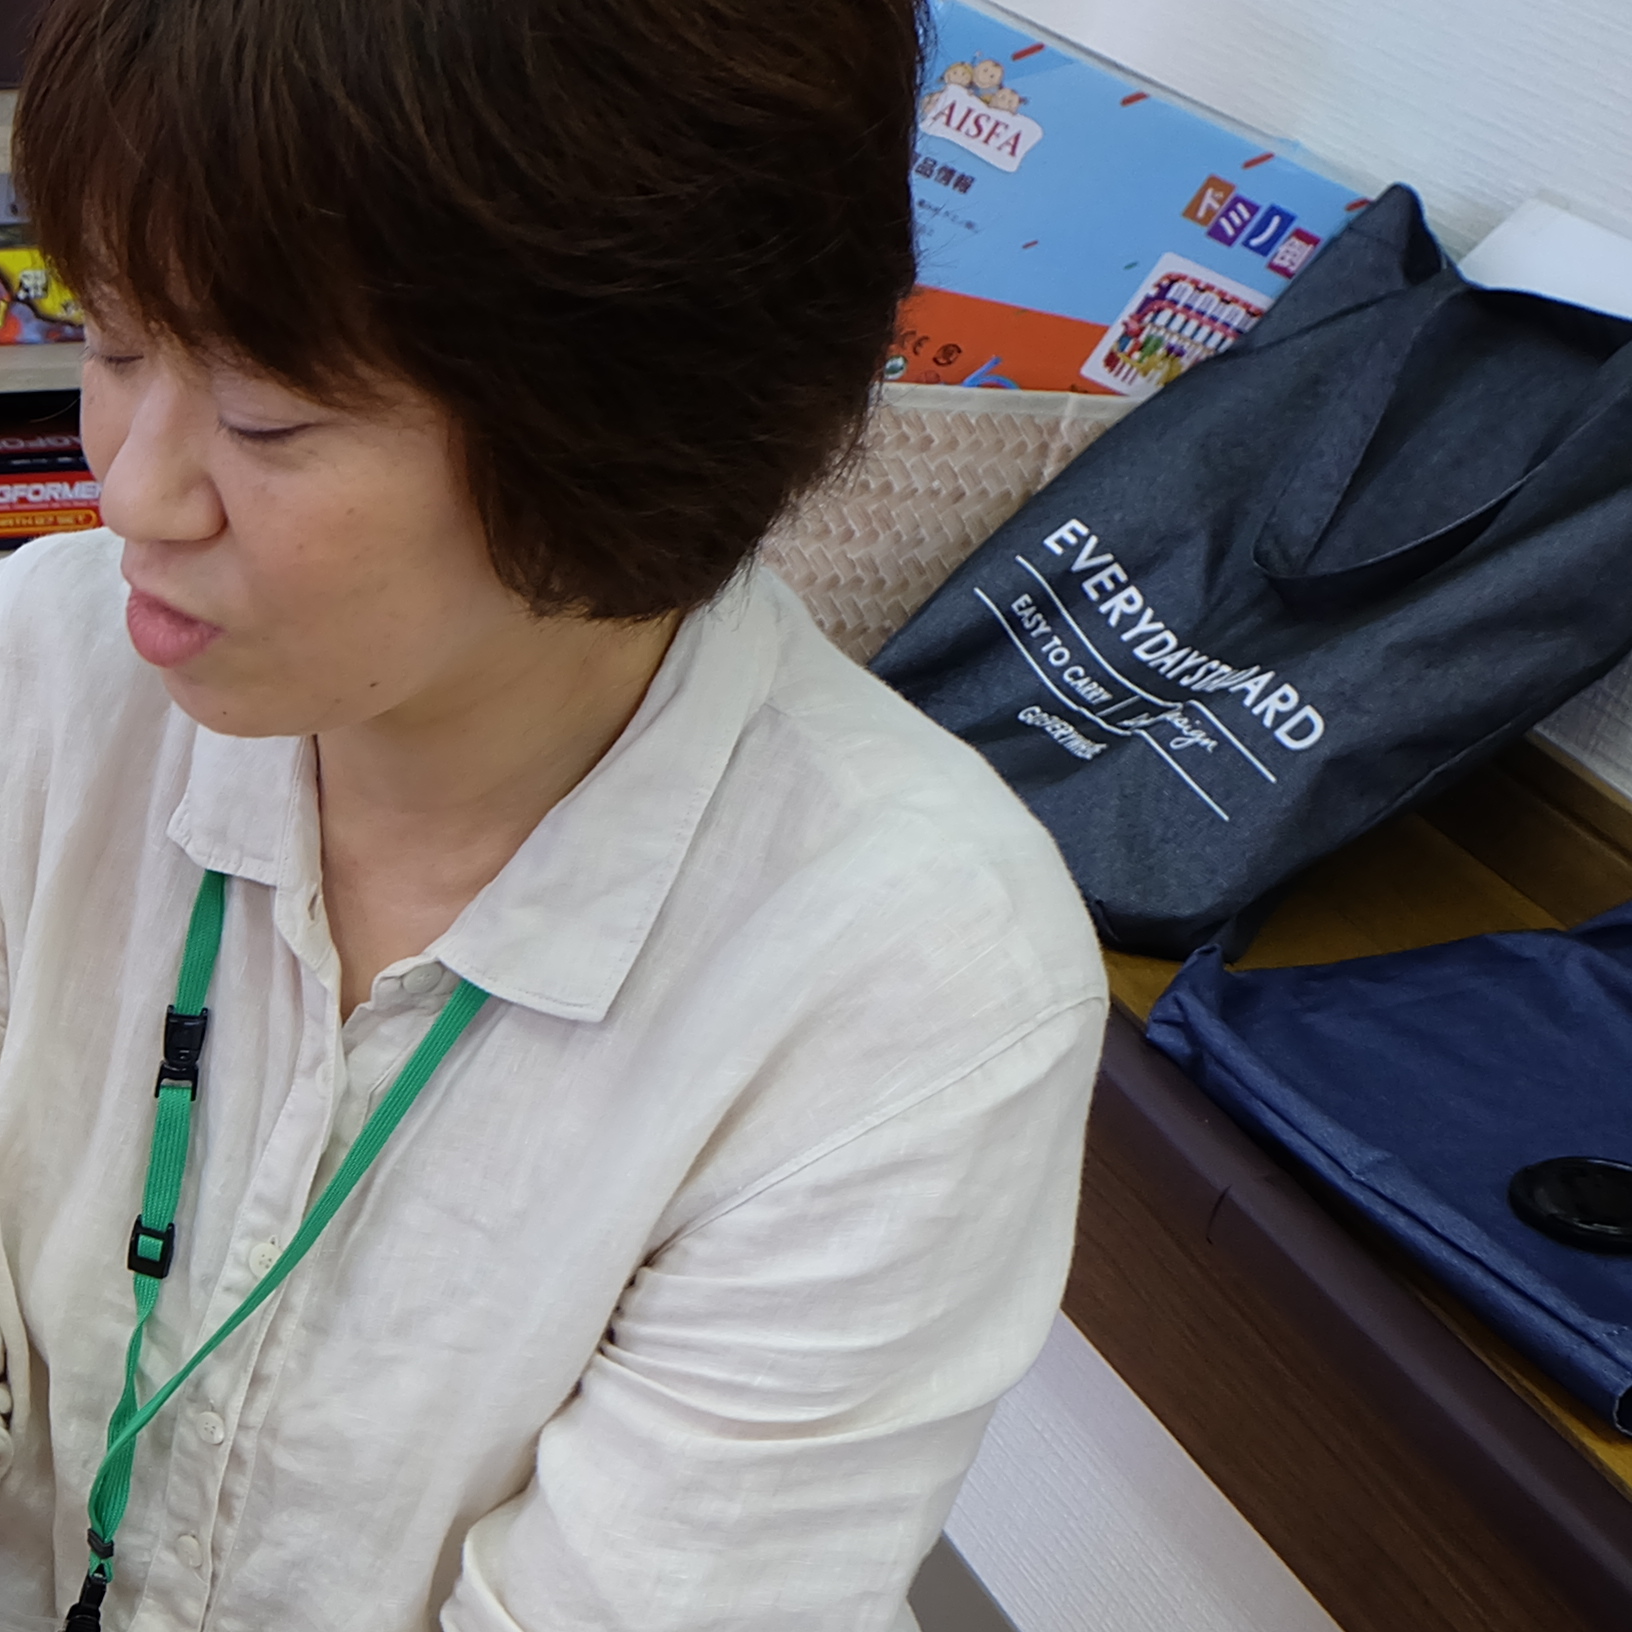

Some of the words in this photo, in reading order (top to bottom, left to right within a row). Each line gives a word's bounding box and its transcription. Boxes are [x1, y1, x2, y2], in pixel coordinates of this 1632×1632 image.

[931, 98, 1028, 159] AISFA
[1010, 592, 1052, 639] EASY
[1040, 634, 1071, 668] TO
[1062, 665, 1114, 706] CARRY
